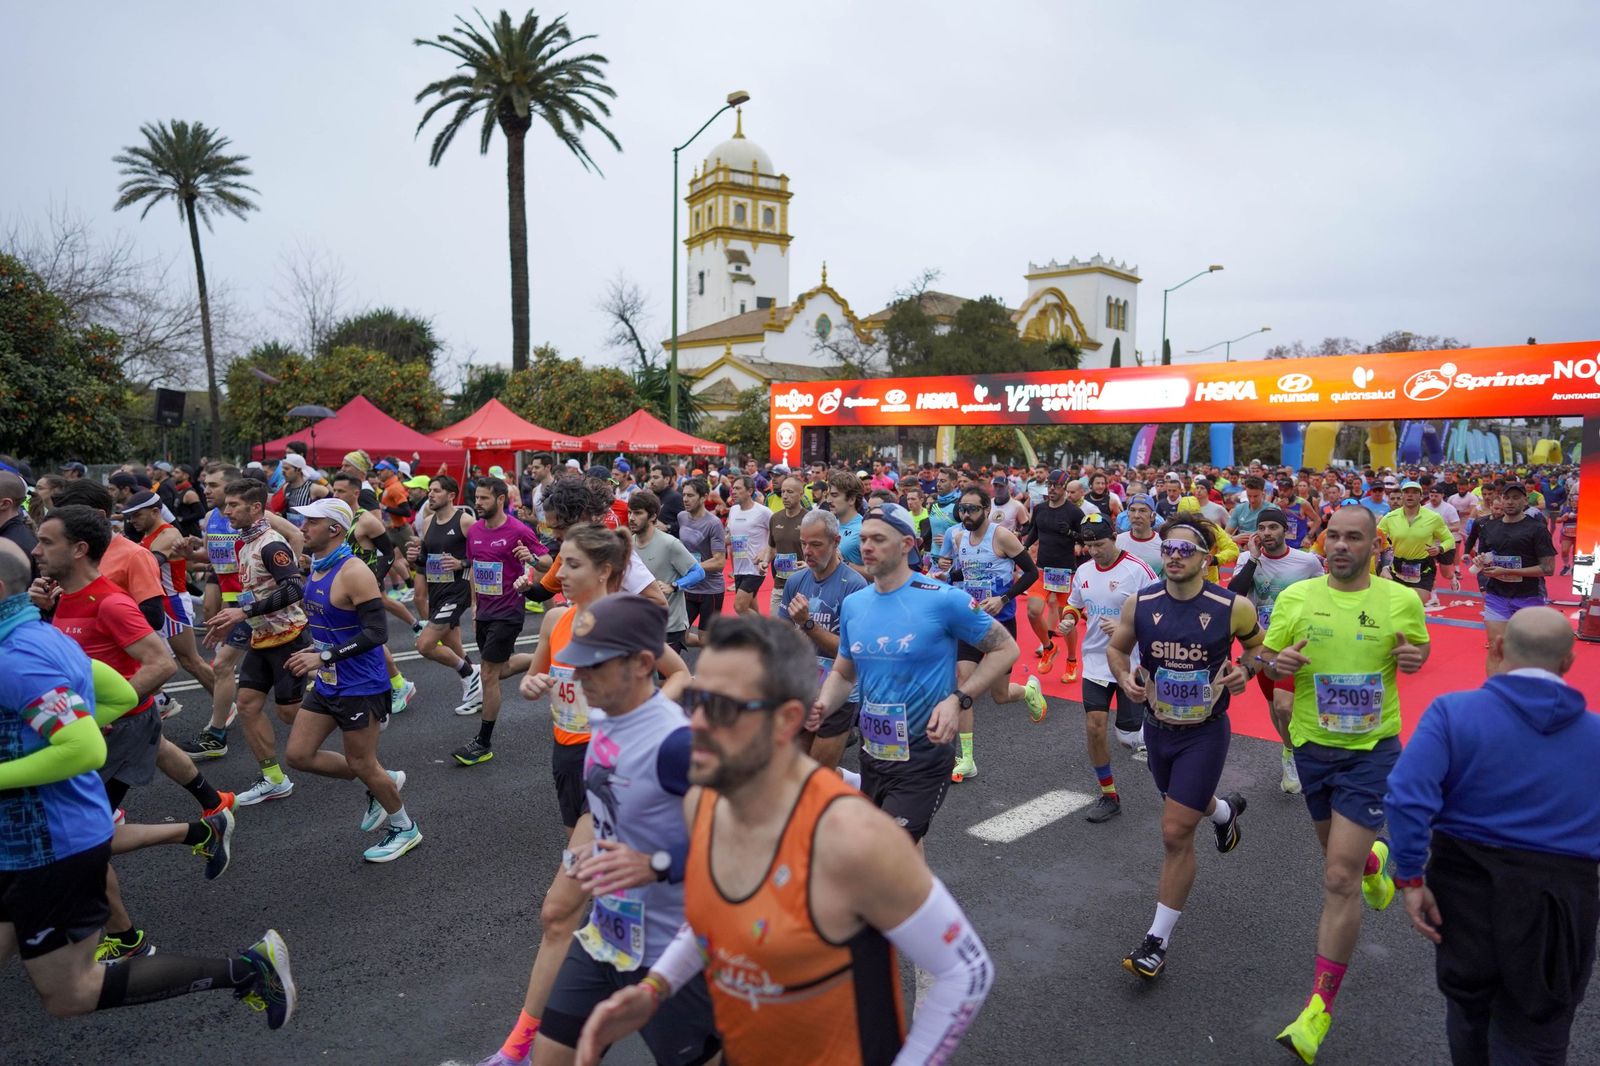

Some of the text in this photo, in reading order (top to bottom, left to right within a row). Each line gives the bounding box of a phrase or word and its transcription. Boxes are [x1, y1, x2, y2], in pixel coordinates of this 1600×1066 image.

[1029, 380, 1099, 398] maratón
[1194, 379, 1258, 401] HOKA
[1453, 372, 1551, 390] Sprinter
[1041, 393, 1099, 412] sevilla
[1269, 393, 1319, 403] HYUNDAI
[476, 569, 494, 580] 2800
[1164, 660, 1194, 669] Telecom
[558, 681, 576, 704] 45
[1163, 681, 1199, 699] 3084
[1327, 688, 1370, 706] 2509
